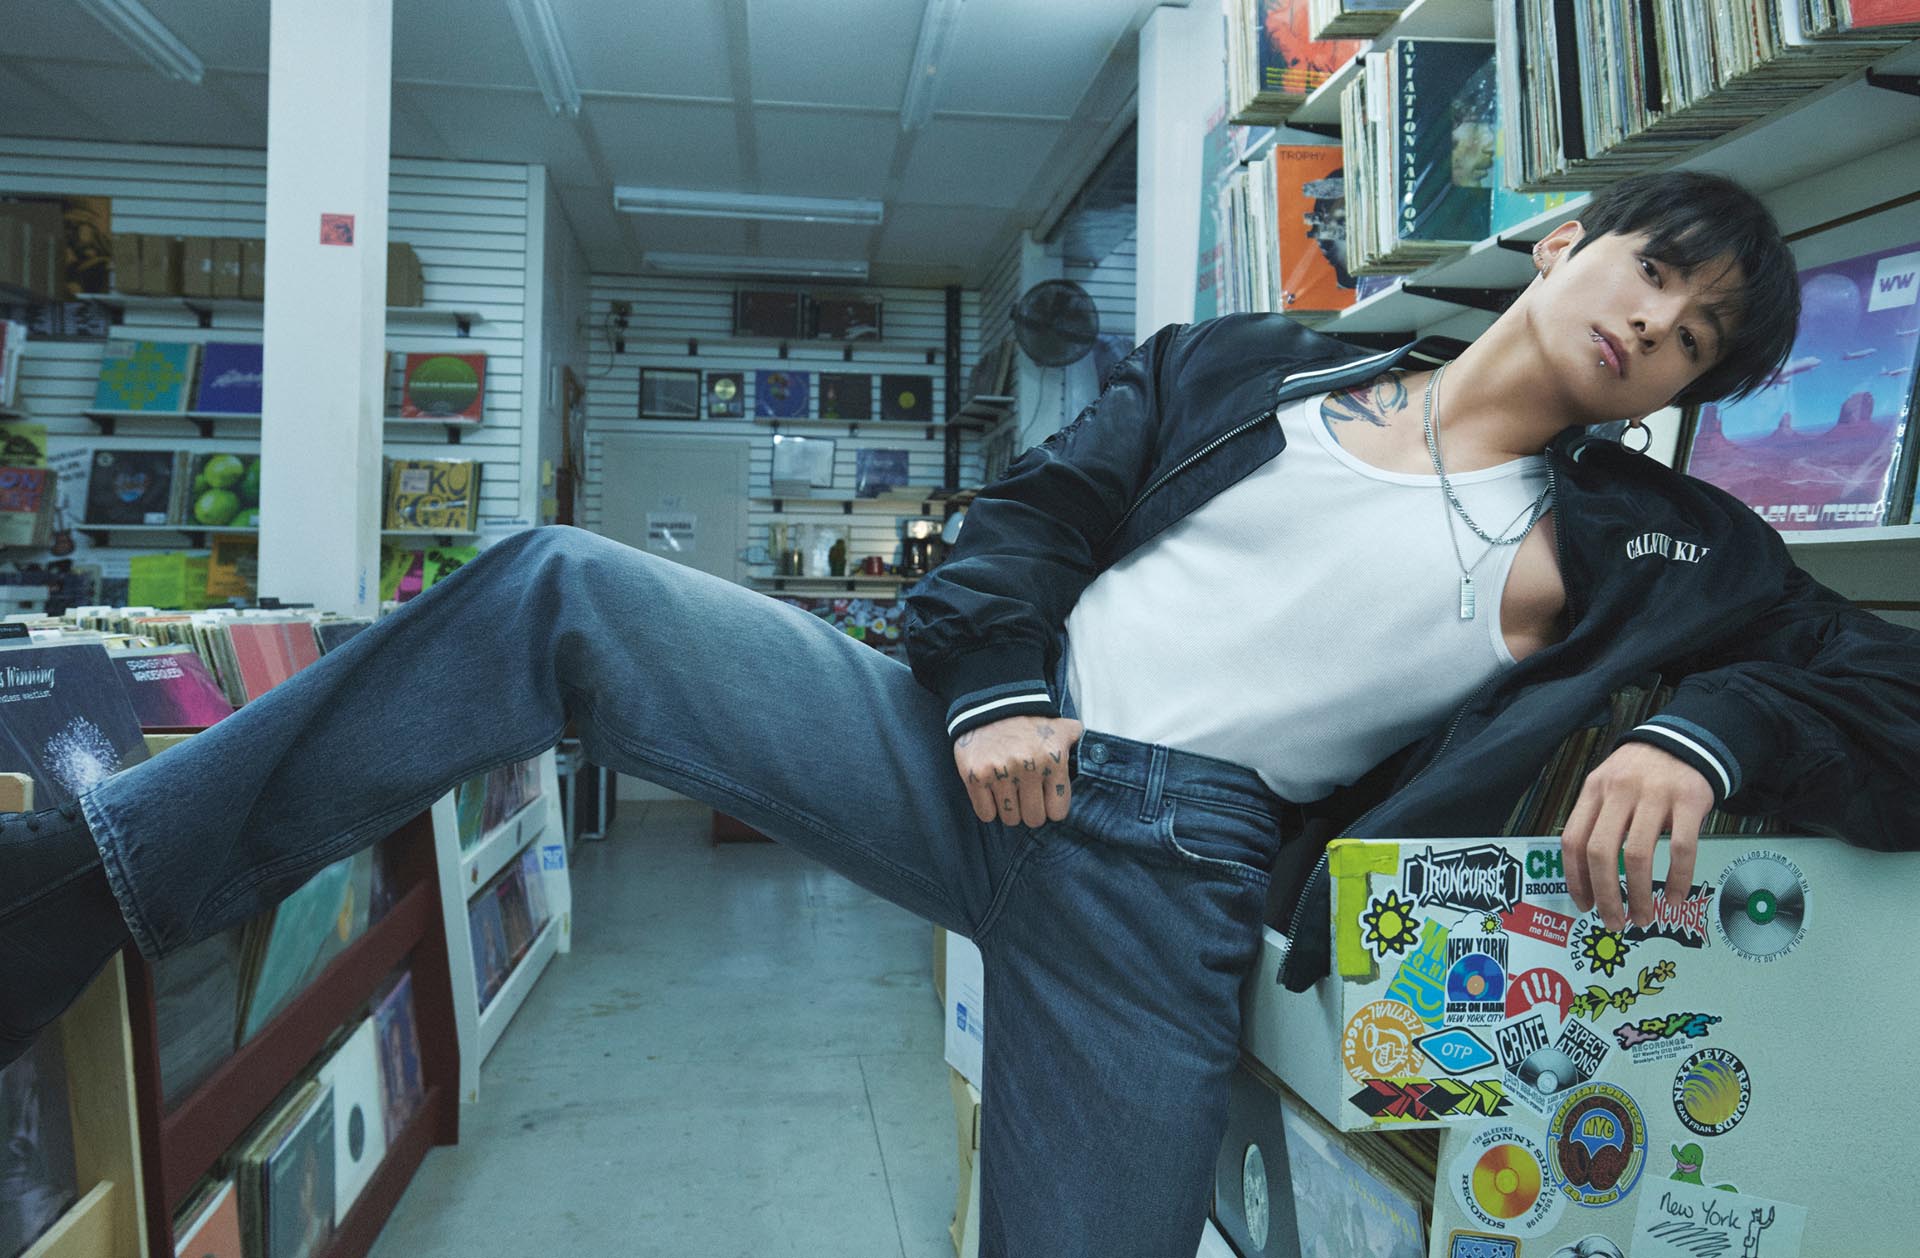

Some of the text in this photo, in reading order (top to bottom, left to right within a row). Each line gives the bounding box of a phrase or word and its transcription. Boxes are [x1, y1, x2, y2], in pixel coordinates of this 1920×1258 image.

[1402, 40, 1416, 148] AVIATION
[1280, 150, 1326, 162] TROPHY
[1879, 271, 1915, 293] WW
[1414, 846, 1516, 910] IRONCURSE
[1529, 926, 1566, 942] me llamo
[1532, 911, 1569, 933] HOLA
[1447, 937, 1506, 970] NEW YORK
[1570, 919, 1589, 972] BRAND
[1366, 1001, 1422, 1031] FESTIVAL
[1446, 1002, 1467, 1013] JAZZ
[1468, 1002, 1481, 1013] ON
[1446, 1013, 1504, 1023] NEW YORK CITY
[1440, 1042, 1473, 1060] OTP
[1499, 1017, 1549, 1066] CRATE
[1564, 1022, 1608, 1059] EXPECT
[1556, 1037, 1600, 1077] ATIONS
[1674, 1049, 1749, 1133] NEXT LEVEL RECORDS
[1583, 1115, 1614, 1138] NYC
[1599, 1085, 1643, 1145] CONNECTOR
[1676, 1104, 1714, 1133] SAN FRAN.
[1481, 1132, 1535, 1149] SONNY
[1483, 1126, 1513, 1138] BLEEKER
[1533, 1148, 1550, 1187] SIDE
[1461, 1173, 1506, 1230] RECORDS
[1533, 1192, 1548, 1213] UP
[1660, 1190, 1742, 1230] New York
